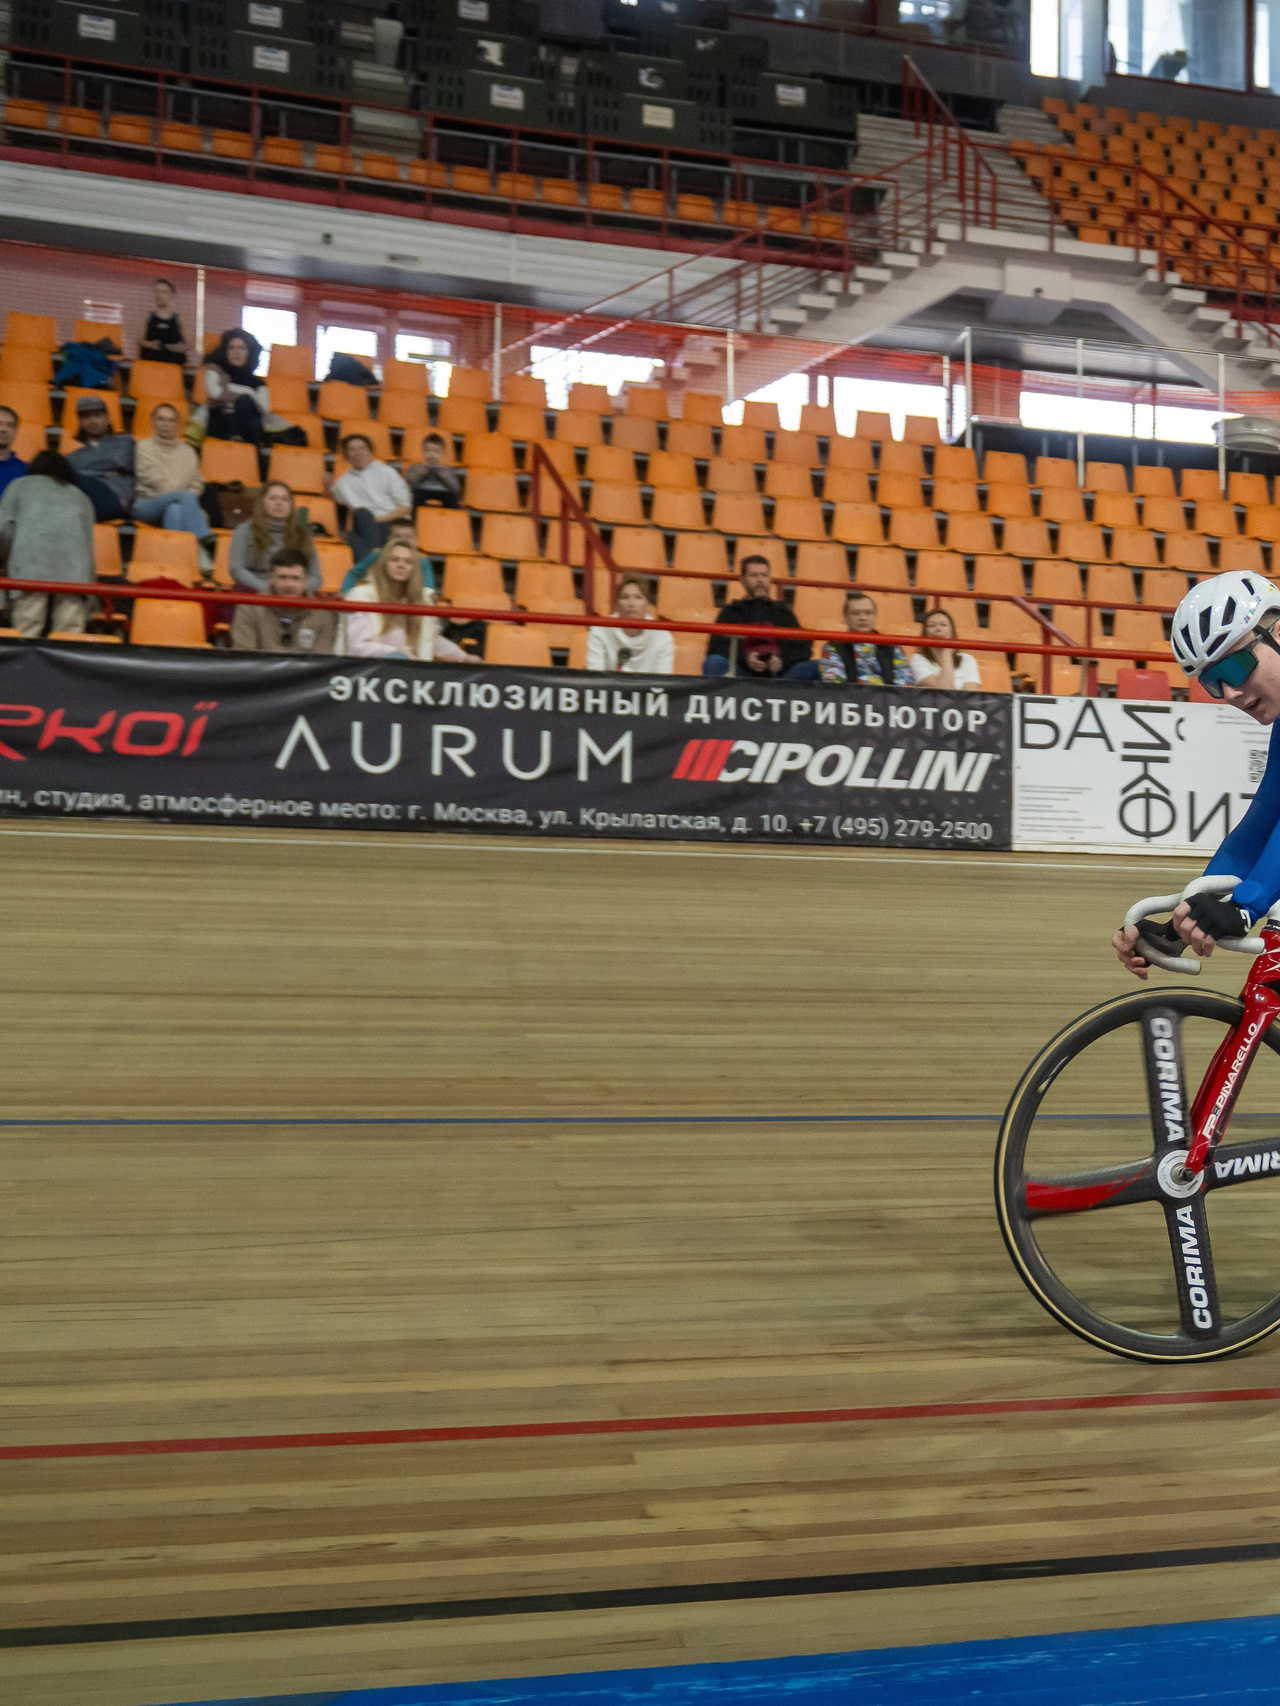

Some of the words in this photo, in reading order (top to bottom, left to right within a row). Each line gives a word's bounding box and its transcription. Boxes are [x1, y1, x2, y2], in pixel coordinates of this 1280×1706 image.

[329, 674, 669, 717] ЭКСКЛЮЗИВНЫЙ
[683, 695, 988, 731] ДИСТРИБЬЮТОР
[717, 740, 996, 793] CIPOLLINI
[138, 793, 313, 820] атмосферное
[319, 802, 402, 820] место:
[407, 804, 427, 821] г.
[434, 802, 533, 826] Москва,
[539, 810, 573, 829] ул.
[579, 808, 727, 833] Крылатская,
[732, 817, 753, 834] д.
[762, 815, 792, 833] 10.
[799, 817, 826, 834] +7
[832, 816, 889, 840] (495)
[894, 818, 993, 841] 279-2500
[1149, 1017, 1186, 1143] CORIMA
[1216, 1022, 1258, 1109] PINARELLO
[1185, 1204, 1213, 1330] CORIMA
